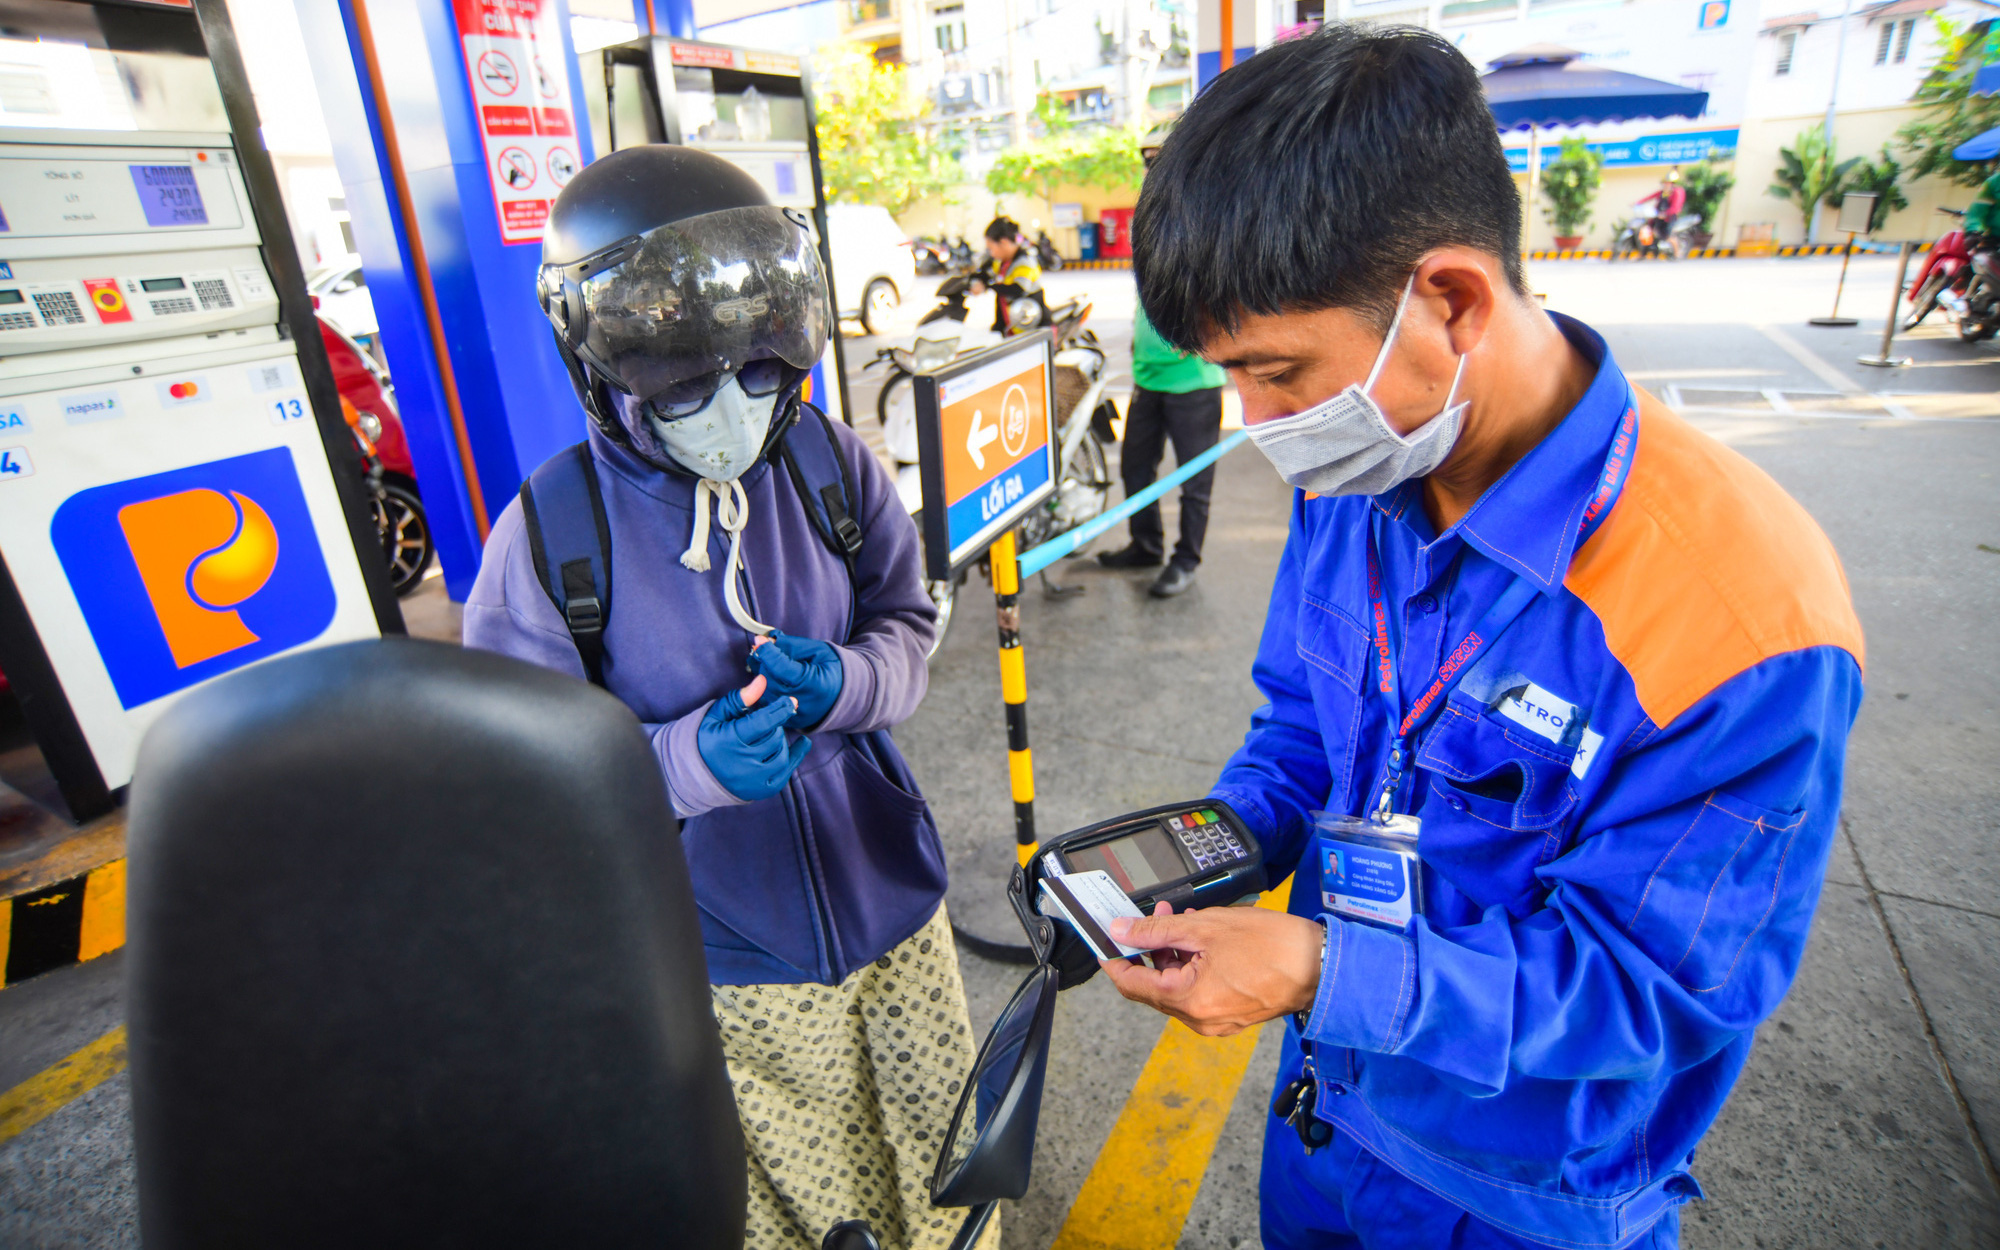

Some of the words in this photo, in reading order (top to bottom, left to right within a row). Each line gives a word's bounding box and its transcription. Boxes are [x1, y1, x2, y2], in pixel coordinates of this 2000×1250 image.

[713, 293, 769, 322] GRS
[275, 399, 303, 421] 13
[981, 478, 1005, 521] LỐI
[1004, 473, 1024, 504] RA
[1584, 485, 1613, 521] XĂNG
[1373, 601, 1393, 693] Petrolimex
[1439, 631, 1484, 682] SAIGON
[1347, 898, 1379, 912] Petrolimex
